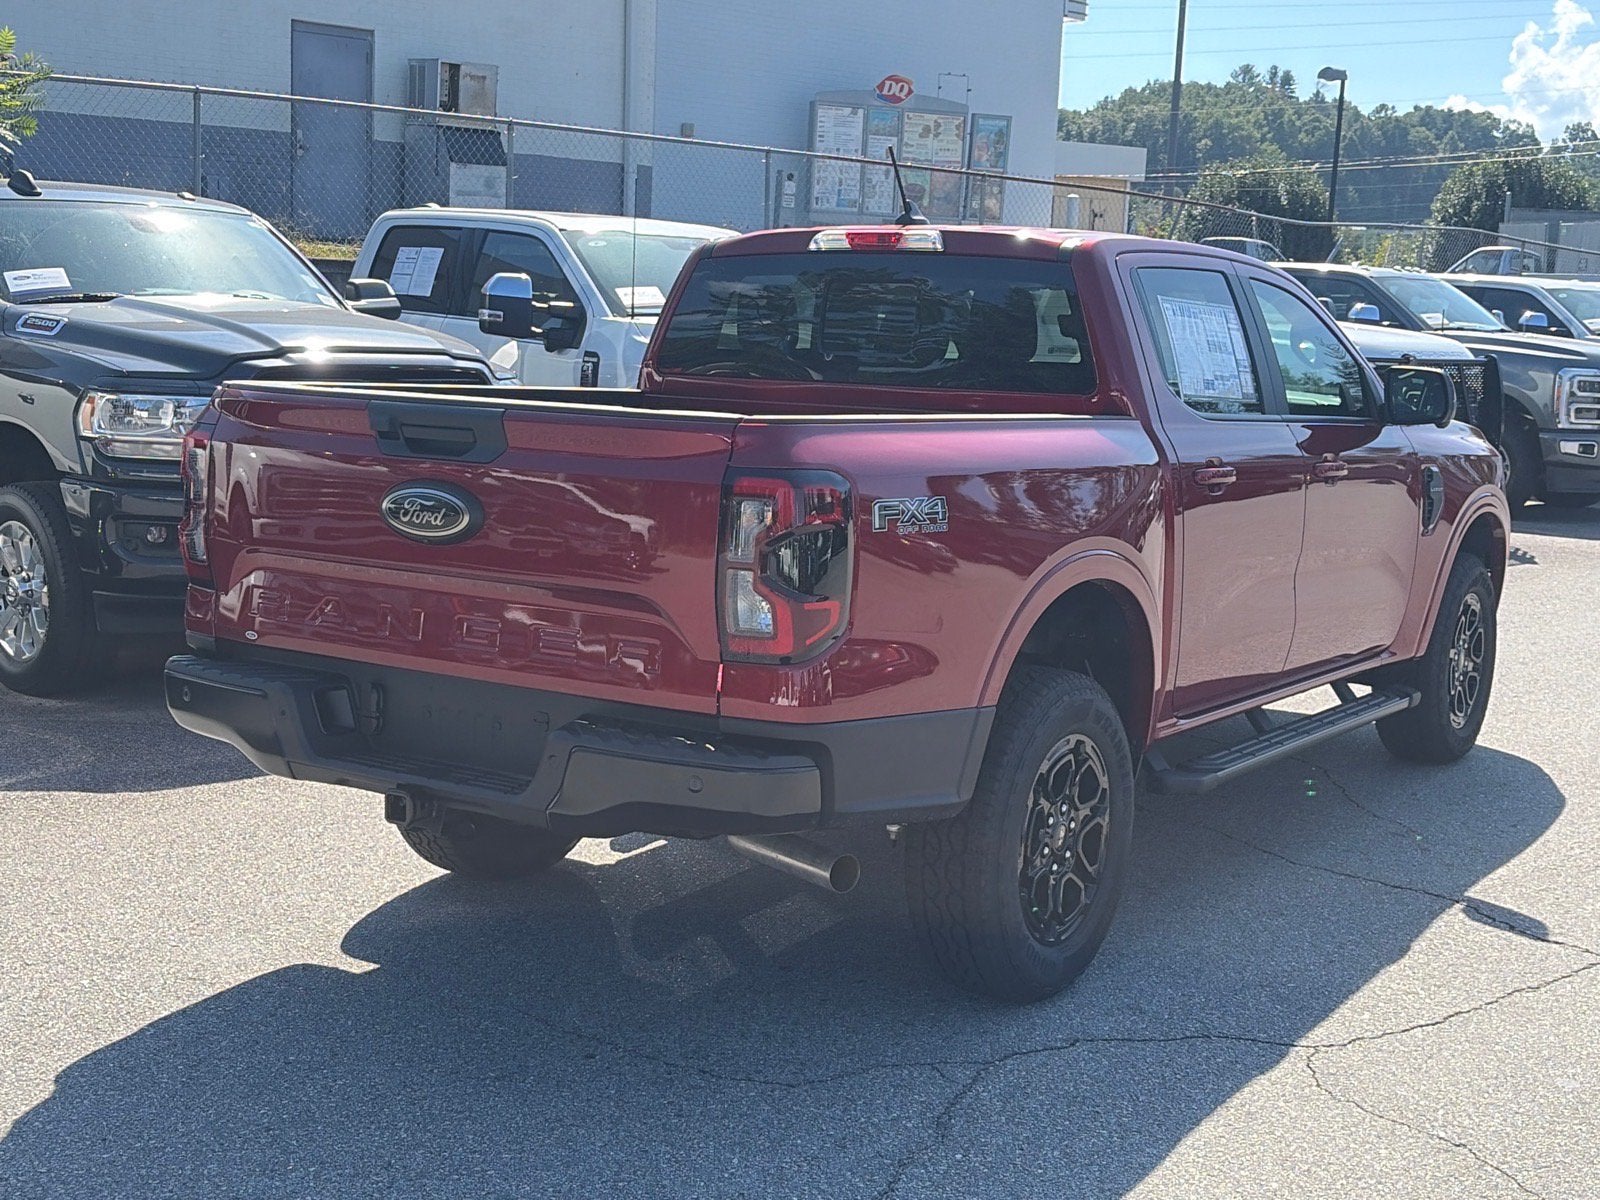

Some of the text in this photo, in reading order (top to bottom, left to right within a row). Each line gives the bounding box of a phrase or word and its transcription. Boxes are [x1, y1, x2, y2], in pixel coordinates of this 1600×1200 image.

[882, 80, 909, 99] DQ
[26, 317, 57, 328] 2500
[400, 497, 446, 526] Ford
[872, 496, 948, 532] FX4
[897, 523, 949, 535] OFF ROAD
[247, 584, 664, 675] RANGER
